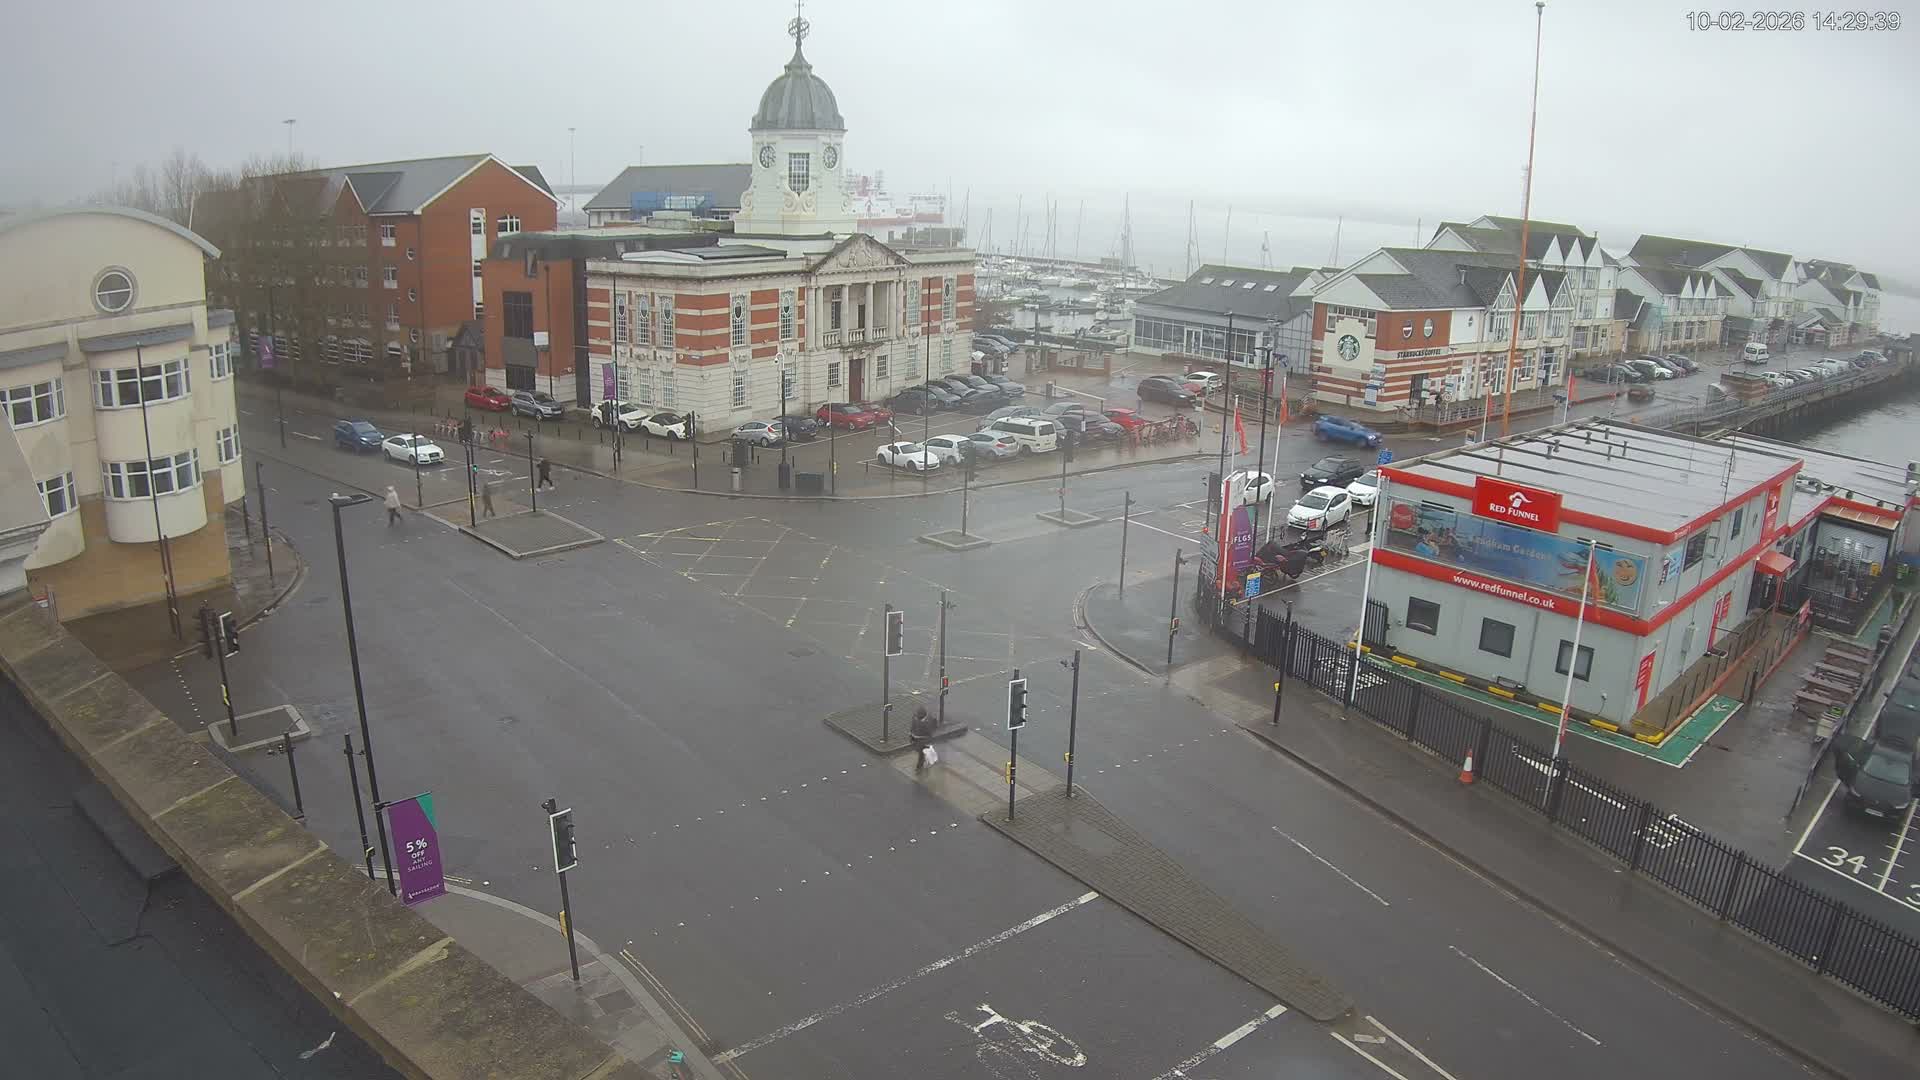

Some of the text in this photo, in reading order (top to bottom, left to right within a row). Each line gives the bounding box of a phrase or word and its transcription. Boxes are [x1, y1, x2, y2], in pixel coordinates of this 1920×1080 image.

[1397, 350, 1424, 359] STARBUCKS
[1489, 502, 1541, 522] RED FUNNEL
[1452, 574, 1555, 610] www.redfunnel.co.uk
[411, 850, 425, 860] OFF
[412, 856, 426, 865] ANY
[1821, 845, 1868, 875] 34
[407, 859, 433, 873] SAILING
